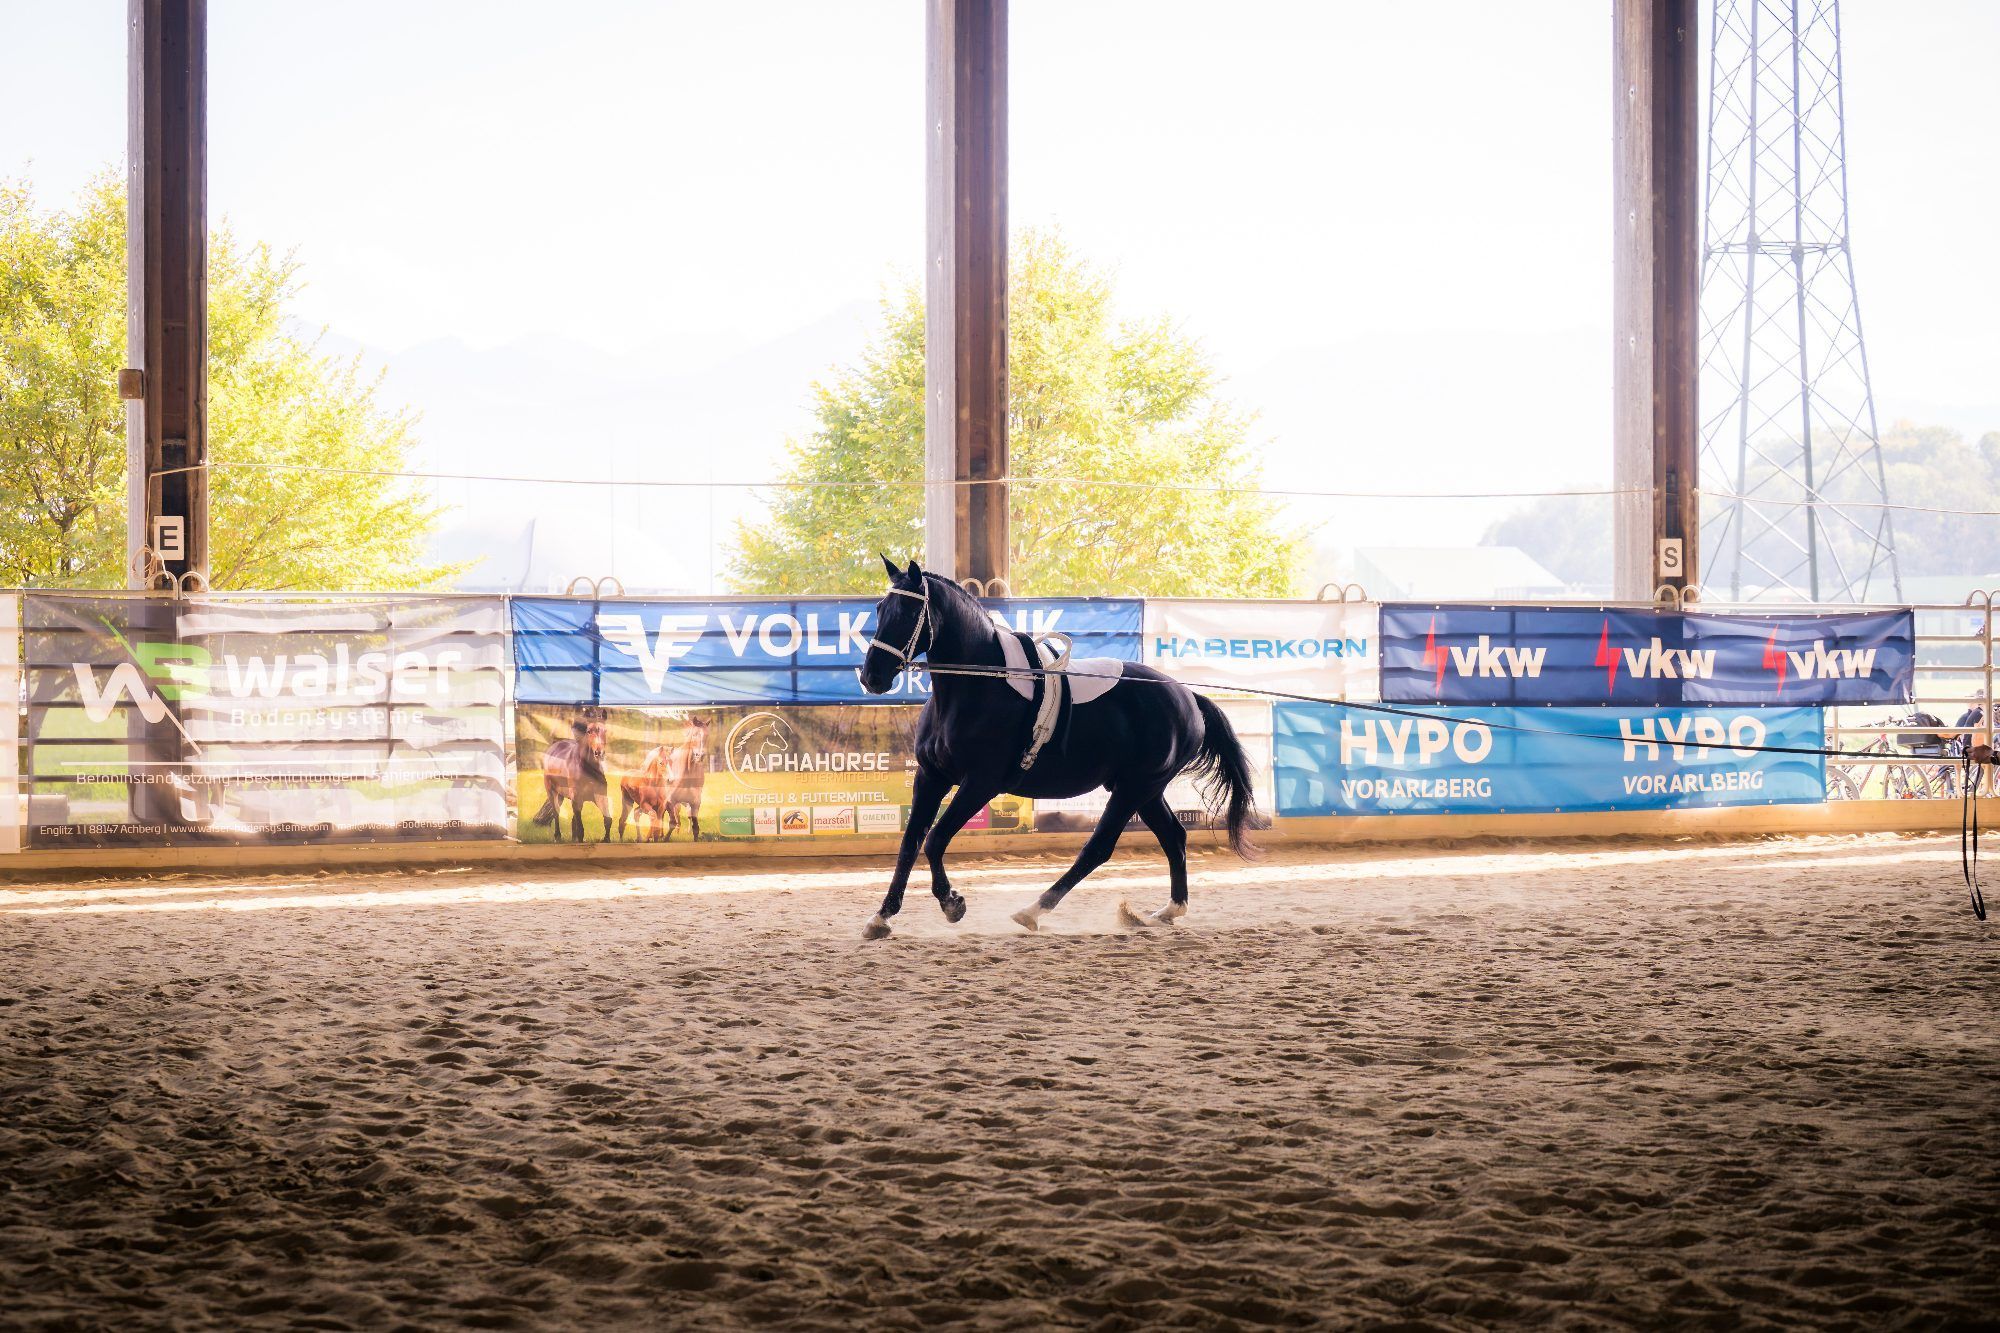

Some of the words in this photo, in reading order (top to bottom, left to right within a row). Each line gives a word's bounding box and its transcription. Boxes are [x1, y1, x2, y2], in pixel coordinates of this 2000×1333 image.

[160, 526, 178, 550] E
[1664, 547, 1678, 568] S
[1156, 637, 1367, 658] HABERKORN
[1450, 635, 1547, 677] vkw
[1623, 638, 1716, 679] vkw
[1786, 640, 1876, 679] vkw
[225, 643, 462, 698] walser
[231, 708, 423, 730] Bodensysteme
[1340, 718, 1493, 764] HYPO
[1619, 716, 1767, 761] HYPO
[740, 752, 890, 772] ALPHAHORSE
[1341, 777, 1492, 799] VORARLBERG
[1623, 771, 1764, 795] VORARLBERG
[723, 794, 783, 804] EINSTREU
[788, 793, 797, 803] &
[801, 791, 890, 803] FUTTERMITTEL
[40, 825, 73, 835] Englitz
[89, 824, 118, 834] 88147
[121, 824, 161, 835] Achberg
